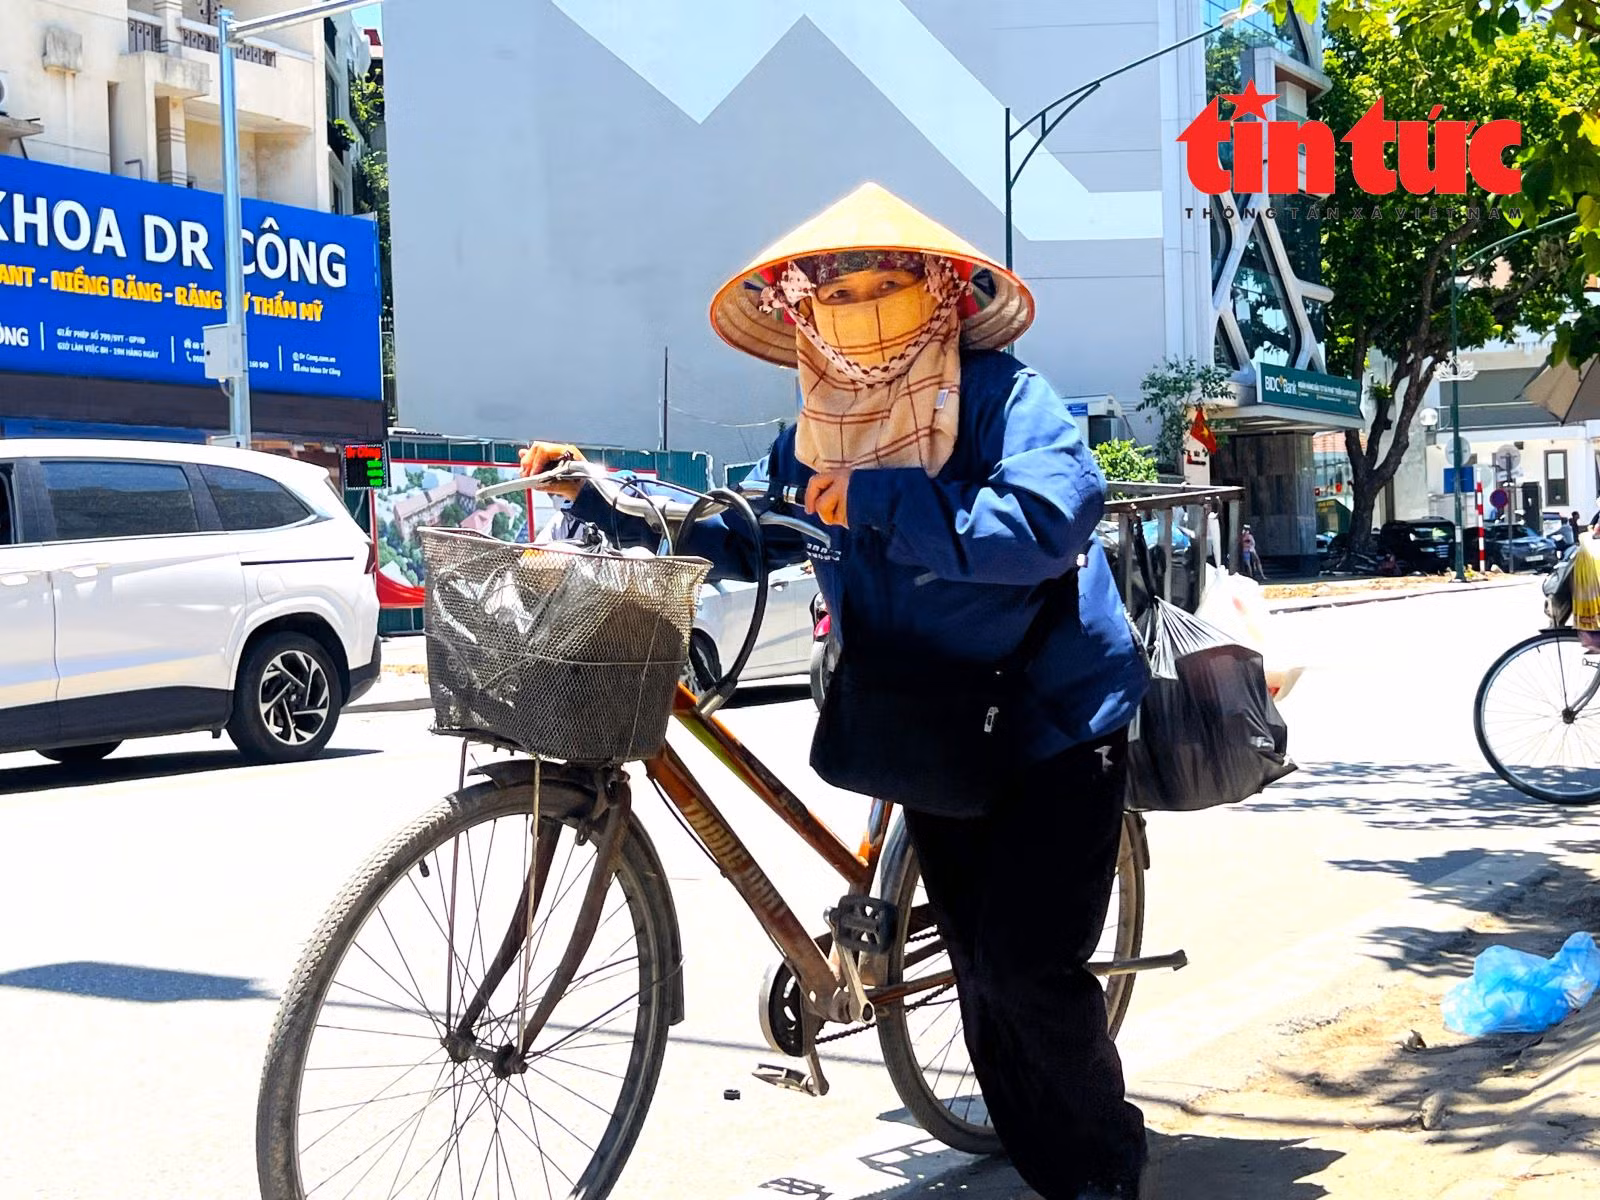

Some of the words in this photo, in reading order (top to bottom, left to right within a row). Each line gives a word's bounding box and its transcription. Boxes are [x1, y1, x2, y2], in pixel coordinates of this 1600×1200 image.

[144, 214, 214, 270] DR
[112, 274, 163, 303] RĂNG
[175, 282, 223, 310] RĂNG
[299, 299, 324, 322] MỸ
